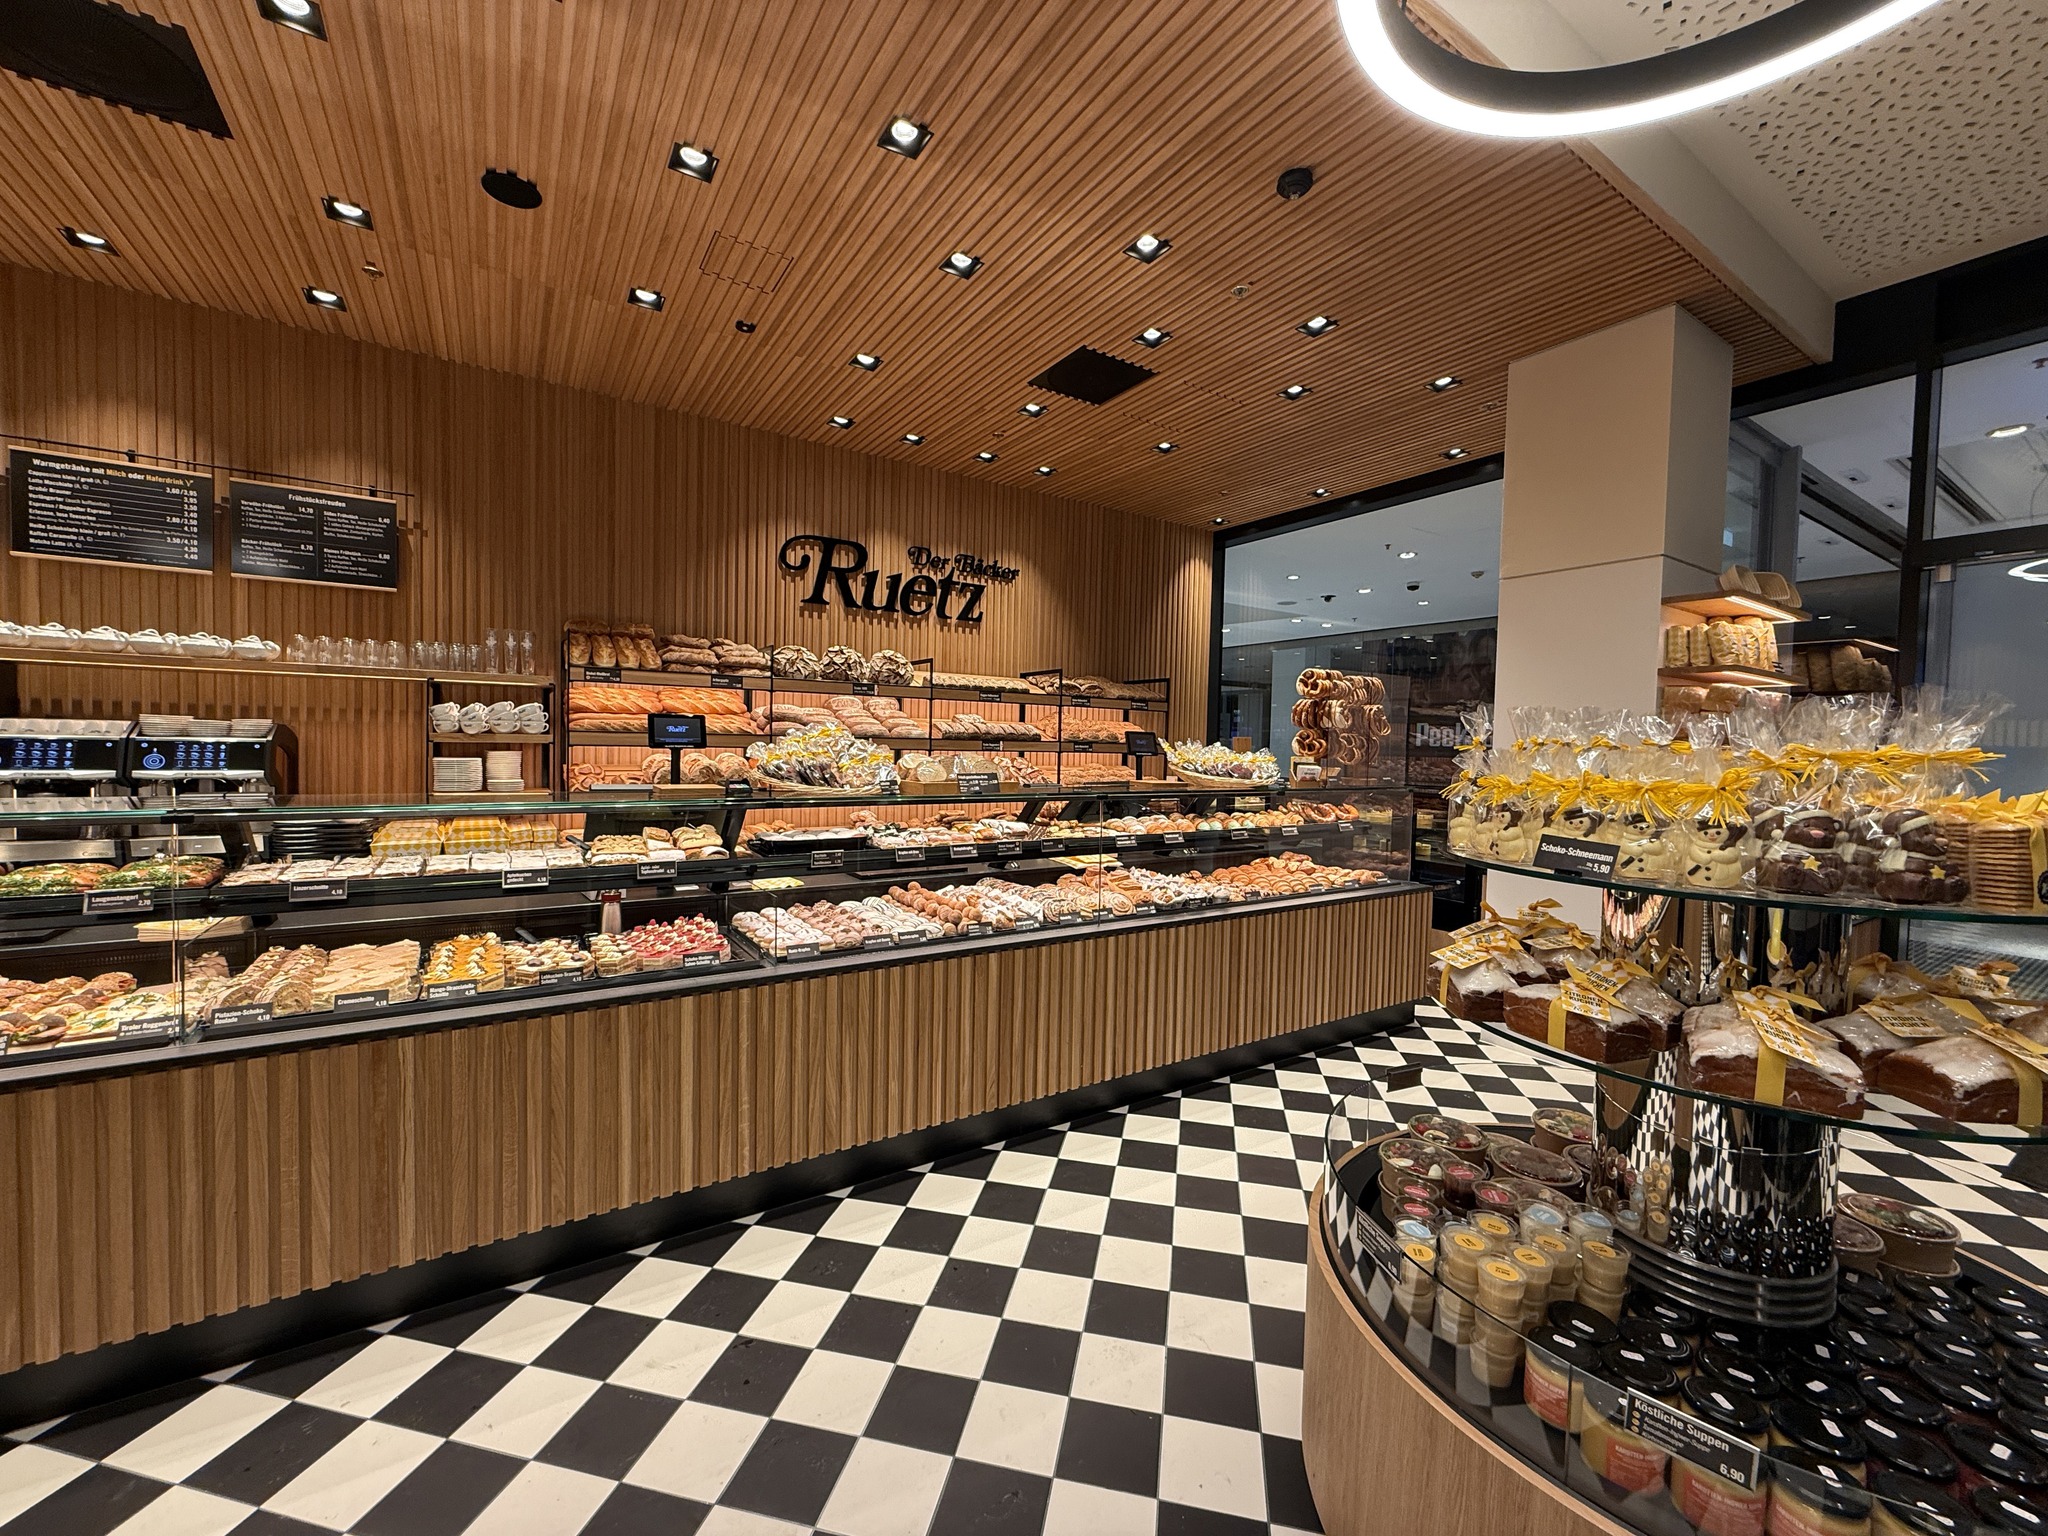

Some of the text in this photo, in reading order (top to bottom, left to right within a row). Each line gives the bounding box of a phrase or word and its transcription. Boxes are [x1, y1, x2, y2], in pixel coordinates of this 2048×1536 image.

[32, 458, 90, 472] Warmgetränke
[106, 468, 126, 478] Milch
[146, 474, 184, 485] Haferdrink
[289, 494, 346, 507] Frühstücksfreuden
[908, 546, 1020, 580] Der Bäcker
[779, 534, 986, 622] Ruetz
[1541, 843, 1614, 863] Schoko-Schneemann
[1592, 864, 1611, 873] 5,90
[92, 894, 138, 903] Laugenstangerl
[1586, 970, 1619, 988] ZITRONEN-
[337, 996, 374, 1005] Cremeschnitte
[1569, 996, 1601, 1008] KUCHEN
[215, 1008, 266, 1018] Pistazien-Schoko-
[1634, 1398, 1729, 1452] Köstliche Suppen
[1719, 1463, 1745, 1484] 6,90
